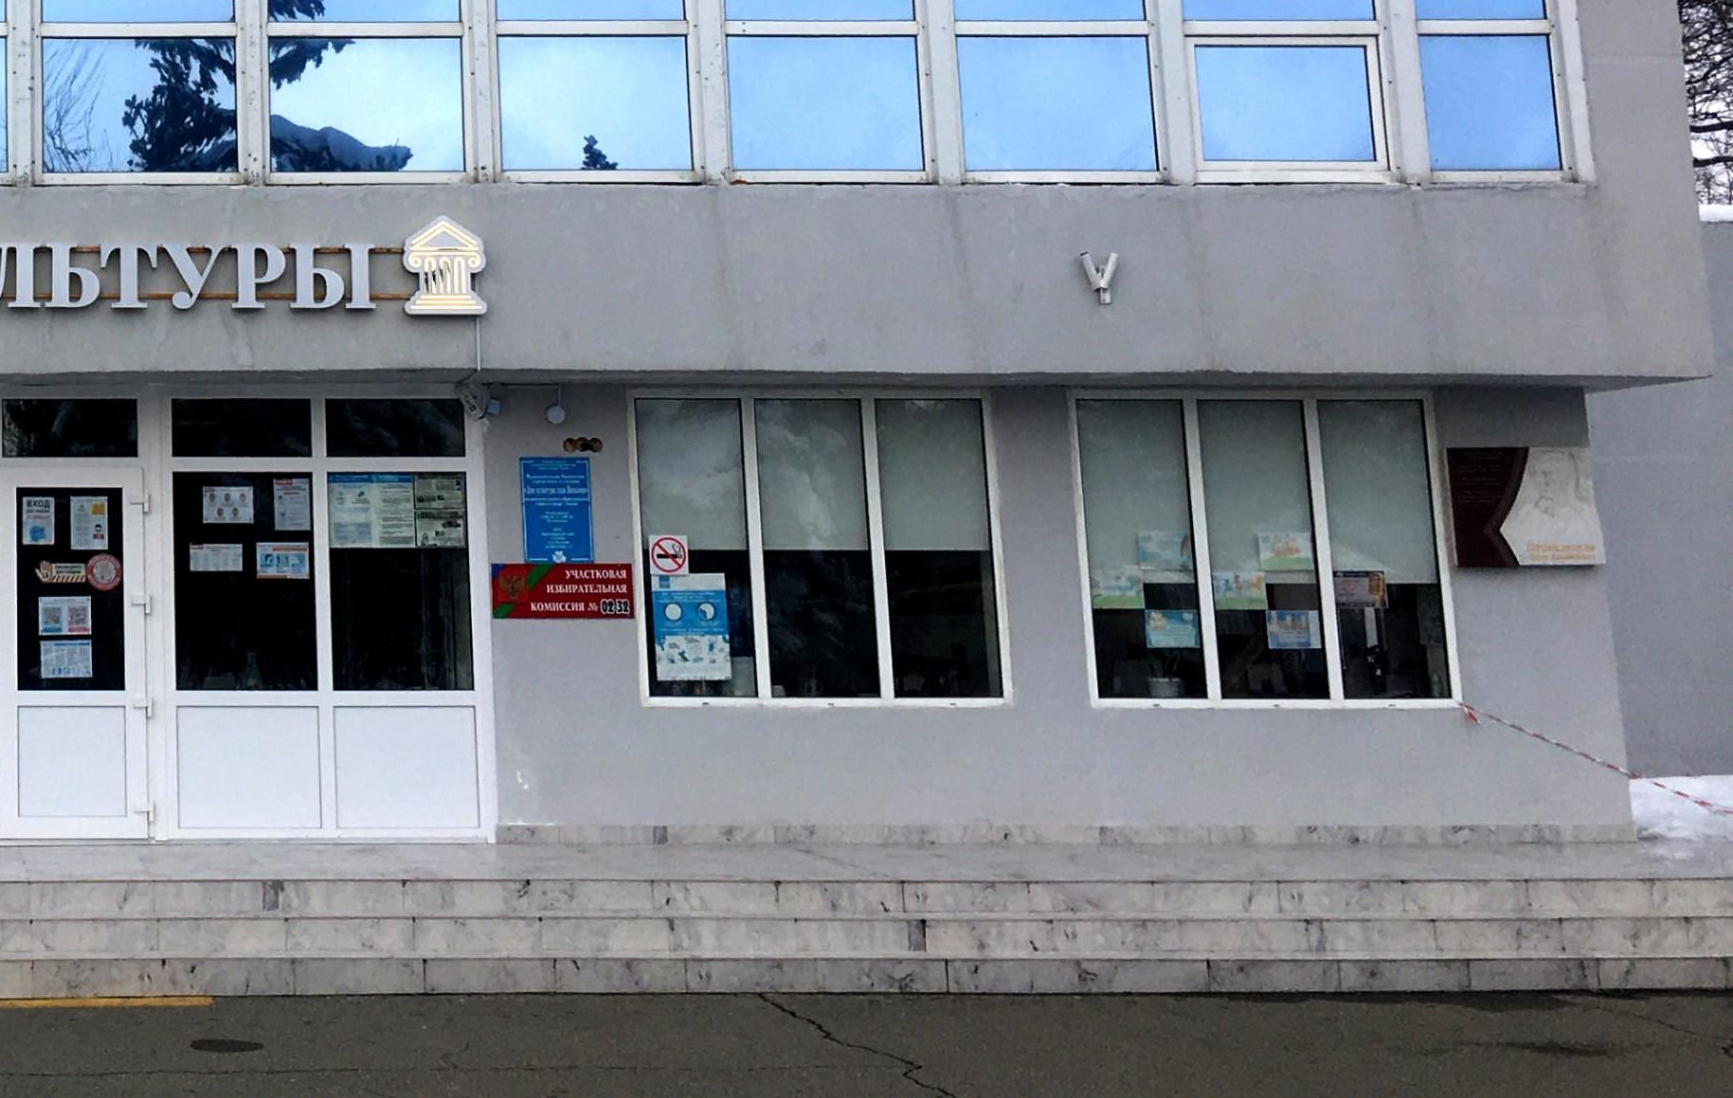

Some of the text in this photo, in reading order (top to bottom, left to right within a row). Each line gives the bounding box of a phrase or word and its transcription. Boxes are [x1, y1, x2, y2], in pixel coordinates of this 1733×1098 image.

[26, 499, 50, 508] ВХОД
[565, 569, 627, 579] УЧАСТКОВАЯ
[546, 584, 627, 594] ИЗБИРАТЕЛЬНАЯ
[530, 602, 585, 612] КОМИССИЯ
